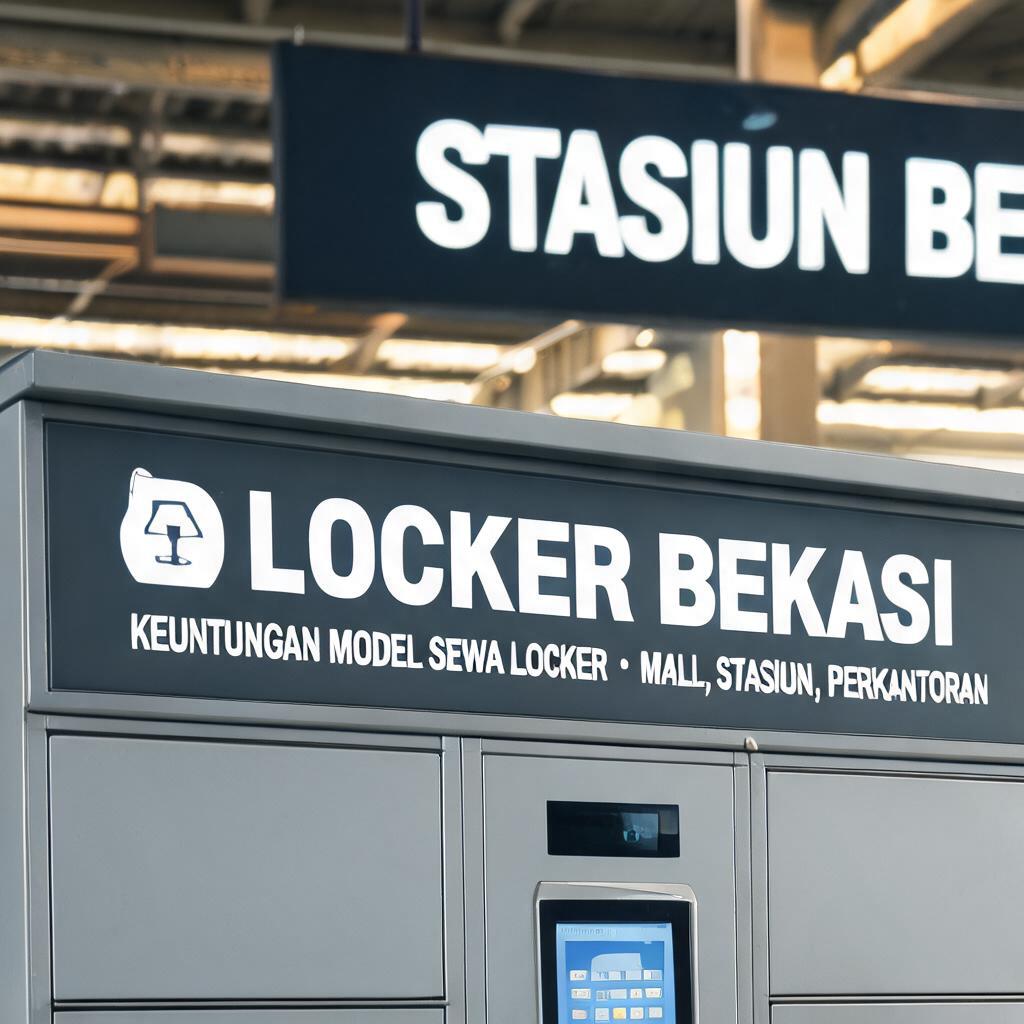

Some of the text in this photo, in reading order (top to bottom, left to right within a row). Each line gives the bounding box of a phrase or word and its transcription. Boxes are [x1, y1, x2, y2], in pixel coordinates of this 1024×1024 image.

[415, 118, 870, 274] STASIUN
[249, 490, 954, 647] LOCKER BEKASI
[130, 612, 989, 705] KEUNTUNGAN MODEL SEWA LOCKER MALL, STASIUN, PERKANTORAN
